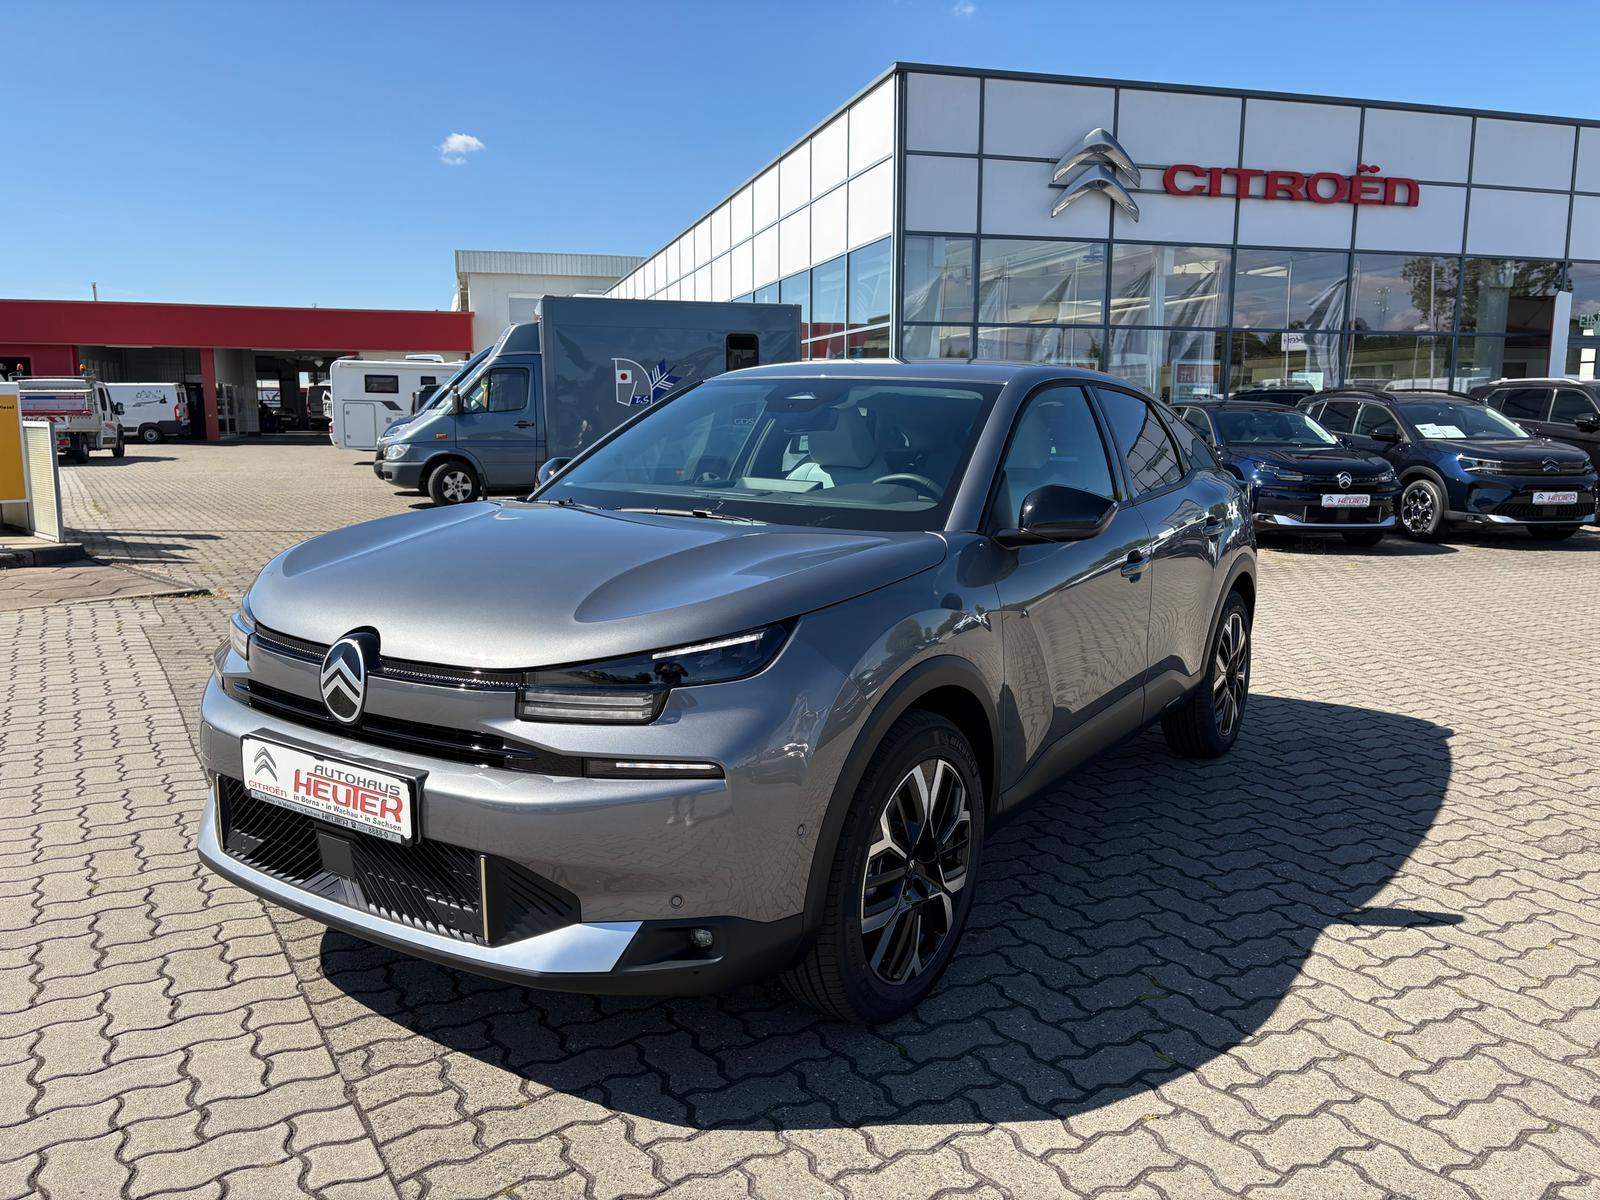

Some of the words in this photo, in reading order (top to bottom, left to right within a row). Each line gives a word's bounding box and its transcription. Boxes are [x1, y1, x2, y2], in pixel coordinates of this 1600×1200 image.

[1163, 164, 1421, 207] CITROËN
[248, 780, 288, 798] CITROËN
[293, 769, 403, 823] HEUTER
[314, 764, 401, 796] AUTOHAUS
[301, 796, 320, 807] Borna
[333, 806, 358, 818] Wachau
[372, 817, 402, 832] Sachsen
